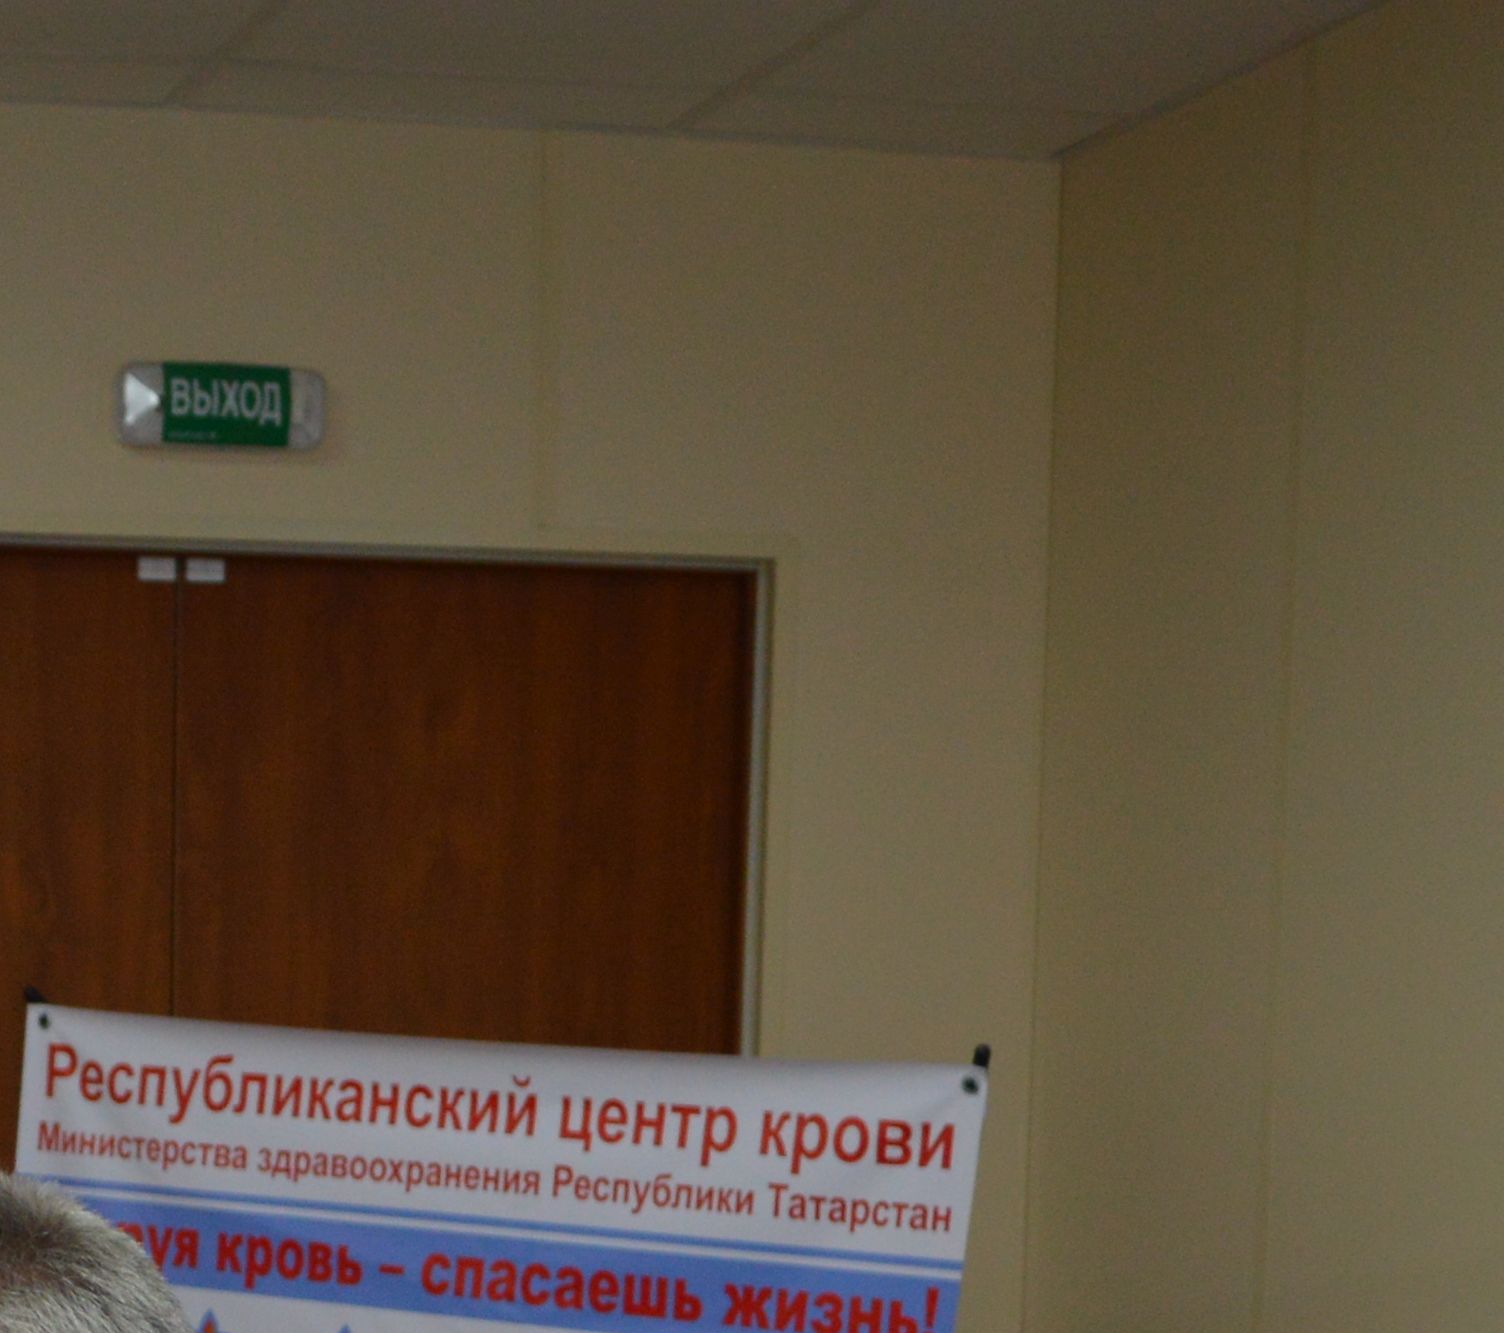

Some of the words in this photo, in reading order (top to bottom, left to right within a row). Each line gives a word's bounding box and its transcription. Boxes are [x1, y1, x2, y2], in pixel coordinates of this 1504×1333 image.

[170, 377, 282, 427] ВЫХОД
[45, 1042, 540, 1137] Республиканский
[558, 1095, 740, 1168] центр
[758, 1109, 956, 1174] крови
[37, 1121, 248, 1170] Министерства
[258, 1147, 541, 1193] здравоохранения
[552, 1164, 754, 1214] Республики
[769, 1182, 953, 1232] Татарстан
[216, 1231, 364, 1290] кровь
[421, 1253, 704, 1323] спасаешь
